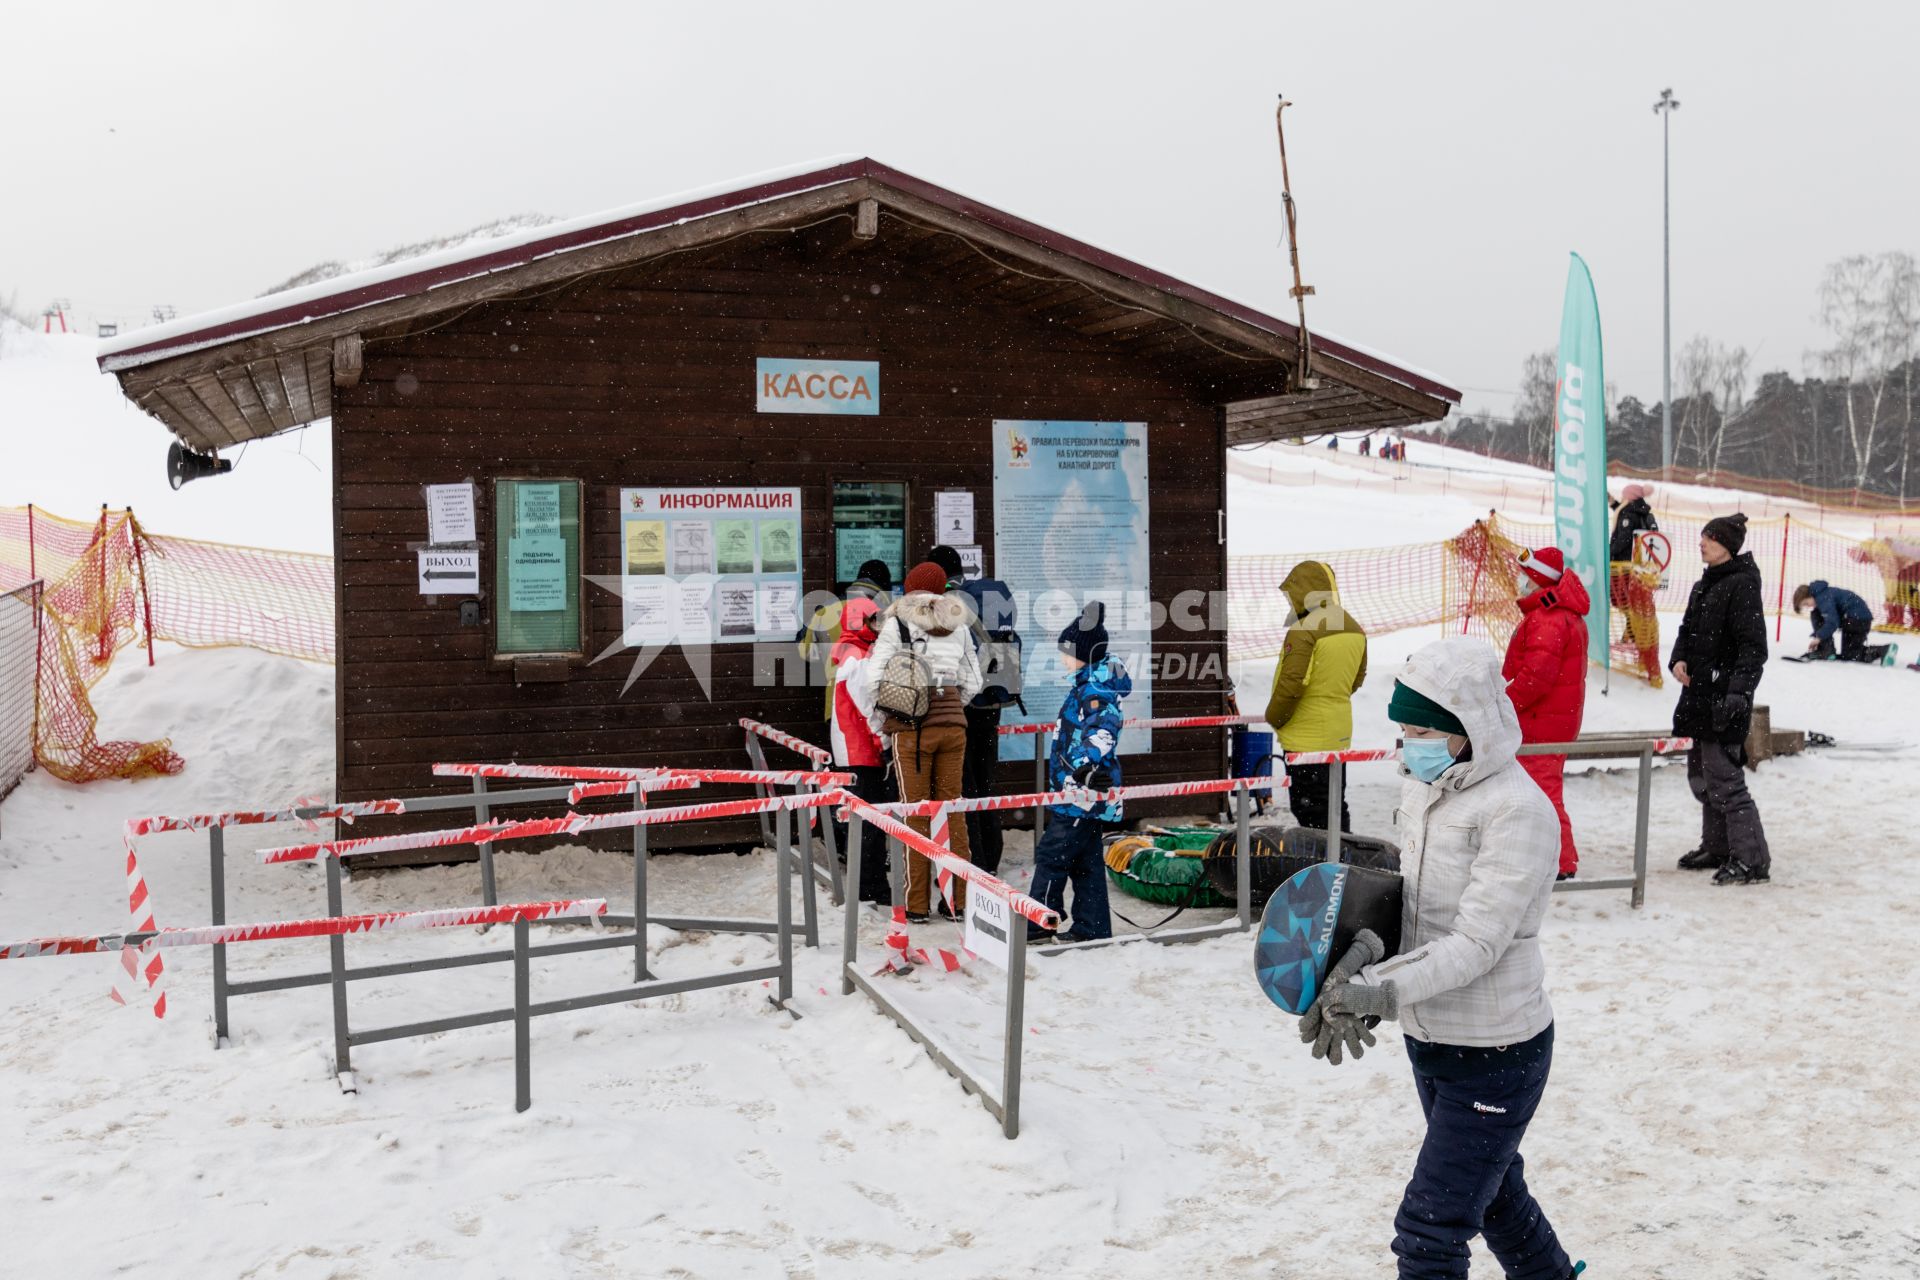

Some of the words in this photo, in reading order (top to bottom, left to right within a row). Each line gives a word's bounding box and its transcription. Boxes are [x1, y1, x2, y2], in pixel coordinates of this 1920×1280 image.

[763, 373, 872, 401] КАССА
[1031, 437, 1061, 447] ПРАВИЛА
[1062, 437, 1098, 447] ПЕРЕВОЗКИ
[1099, 438, 1140, 447] ПАССАЖИРОВ
[1056, 450, 1065, 458] НА
[1066, 448, 1119, 459] БУКСИРОВОЧНОЙ
[1058, 460, 1091, 470] КАНАТНОЙ
[1092, 461, 1116, 471] ДОРОГЕ
[659, 493, 793, 509] ИНФОРМАЦИЯ
[426, 556, 472, 567] ВЫХОД
[975, 893, 1002, 920] ВХОД
[1317, 873, 1345, 954] SALOMON
[1473, 1101, 1507, 1113] Reebok
